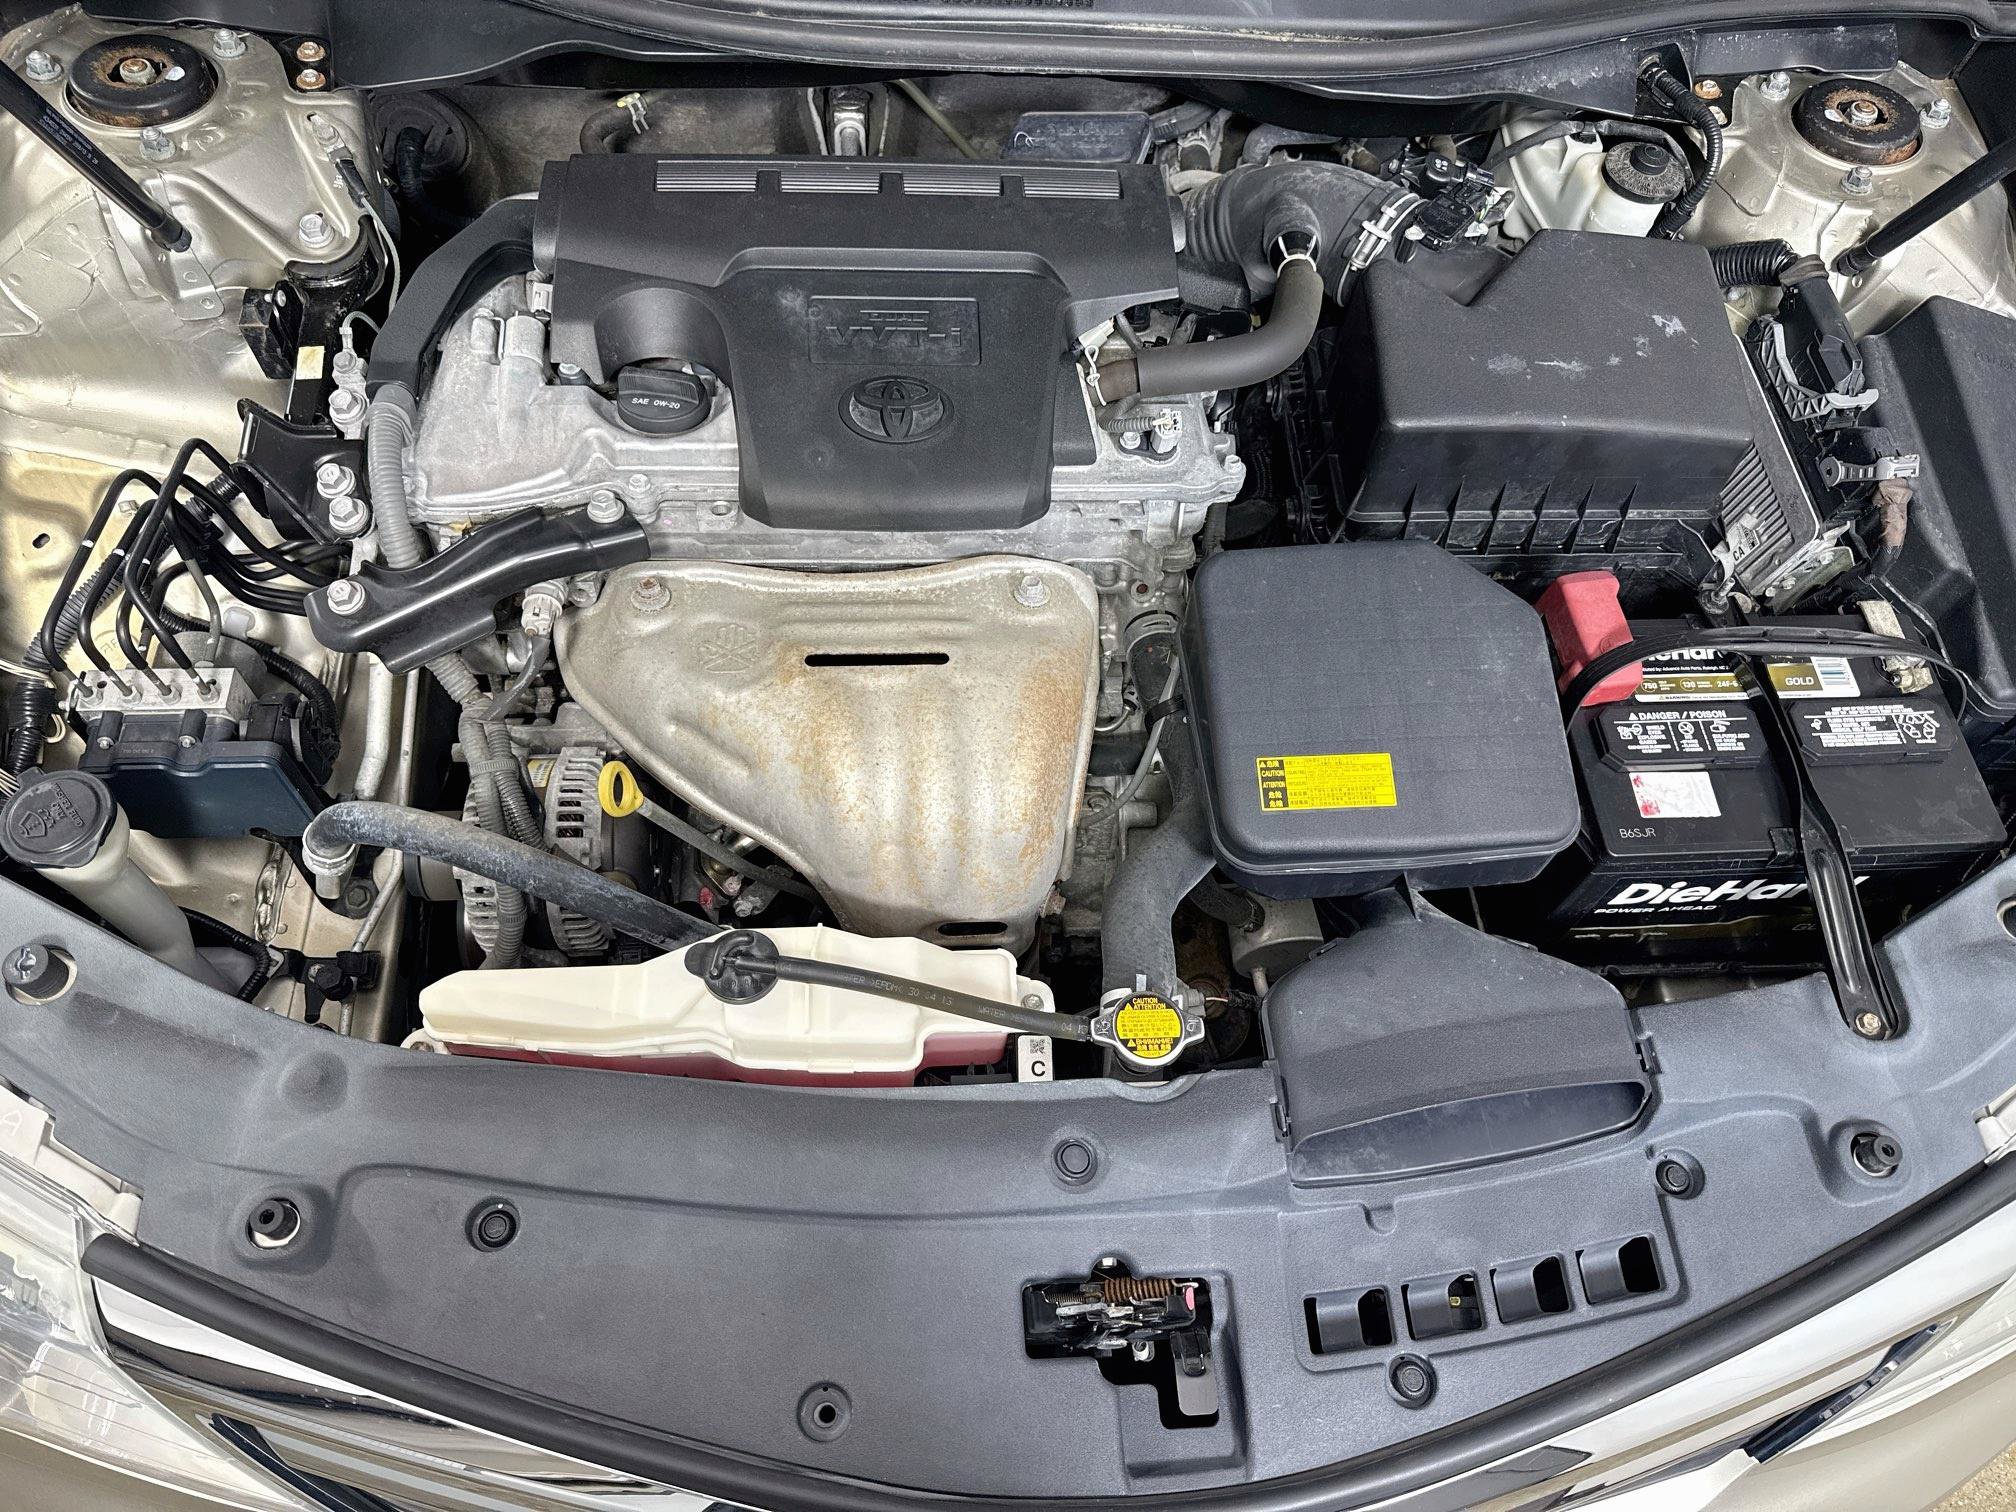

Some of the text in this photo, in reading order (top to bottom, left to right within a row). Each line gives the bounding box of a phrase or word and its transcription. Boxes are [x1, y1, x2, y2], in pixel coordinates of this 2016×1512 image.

[631, 397, 681, 410] SAE 0W-20
[1732, 546, 1746, 562] CA
[1642, 682, 1658, 690] 750
[1785, 677, 1815, 686] GOLD
[1638, 711, 1680, 720] DANGER
[1689, 710, 1727, 719] POISON
[1619, 828, 1657, 839] B6SJR
[1607, 876, 1871, 905] DieHar
[1031, 1060, 1046, 1077] C
